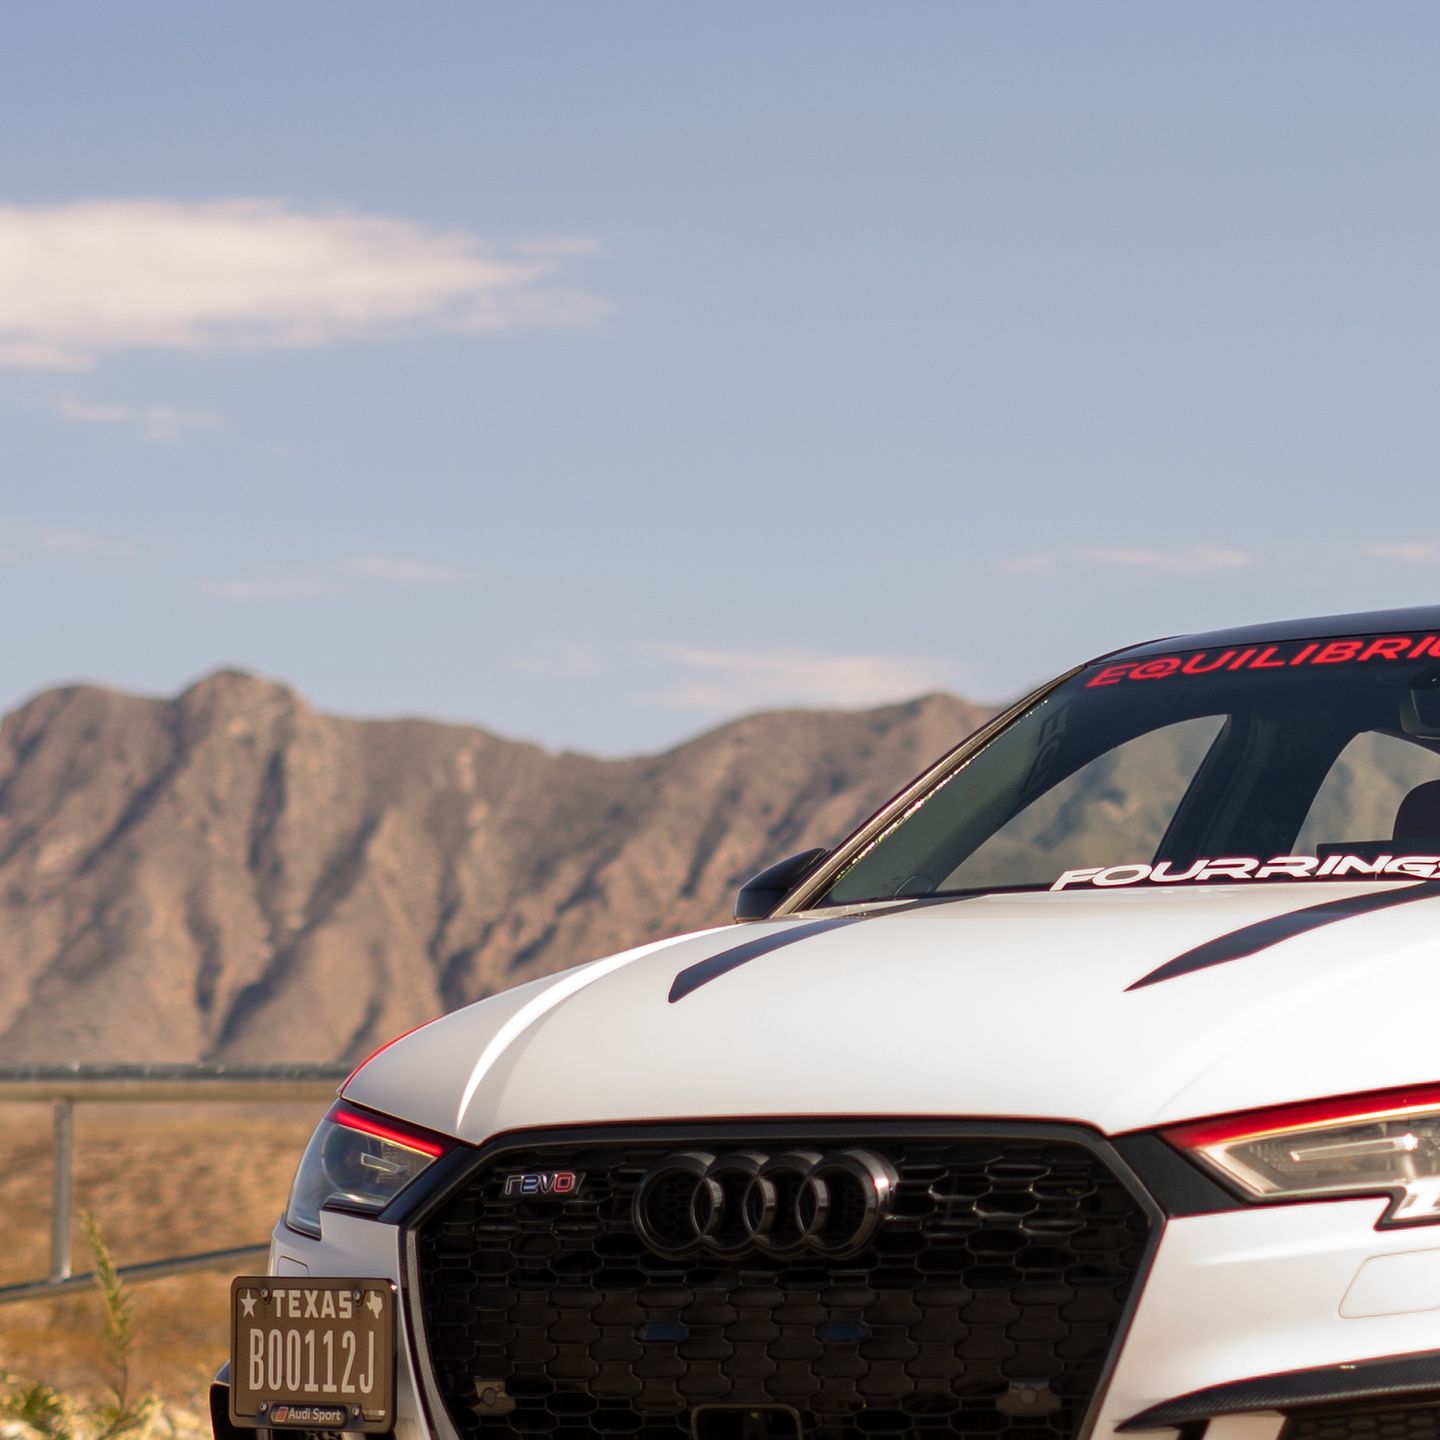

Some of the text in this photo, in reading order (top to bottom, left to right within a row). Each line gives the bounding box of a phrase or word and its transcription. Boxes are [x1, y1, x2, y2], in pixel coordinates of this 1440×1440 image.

[272, 1289, 353, 1319] TEXAS
[288, 1407, 342, 1423] Audi Sport
